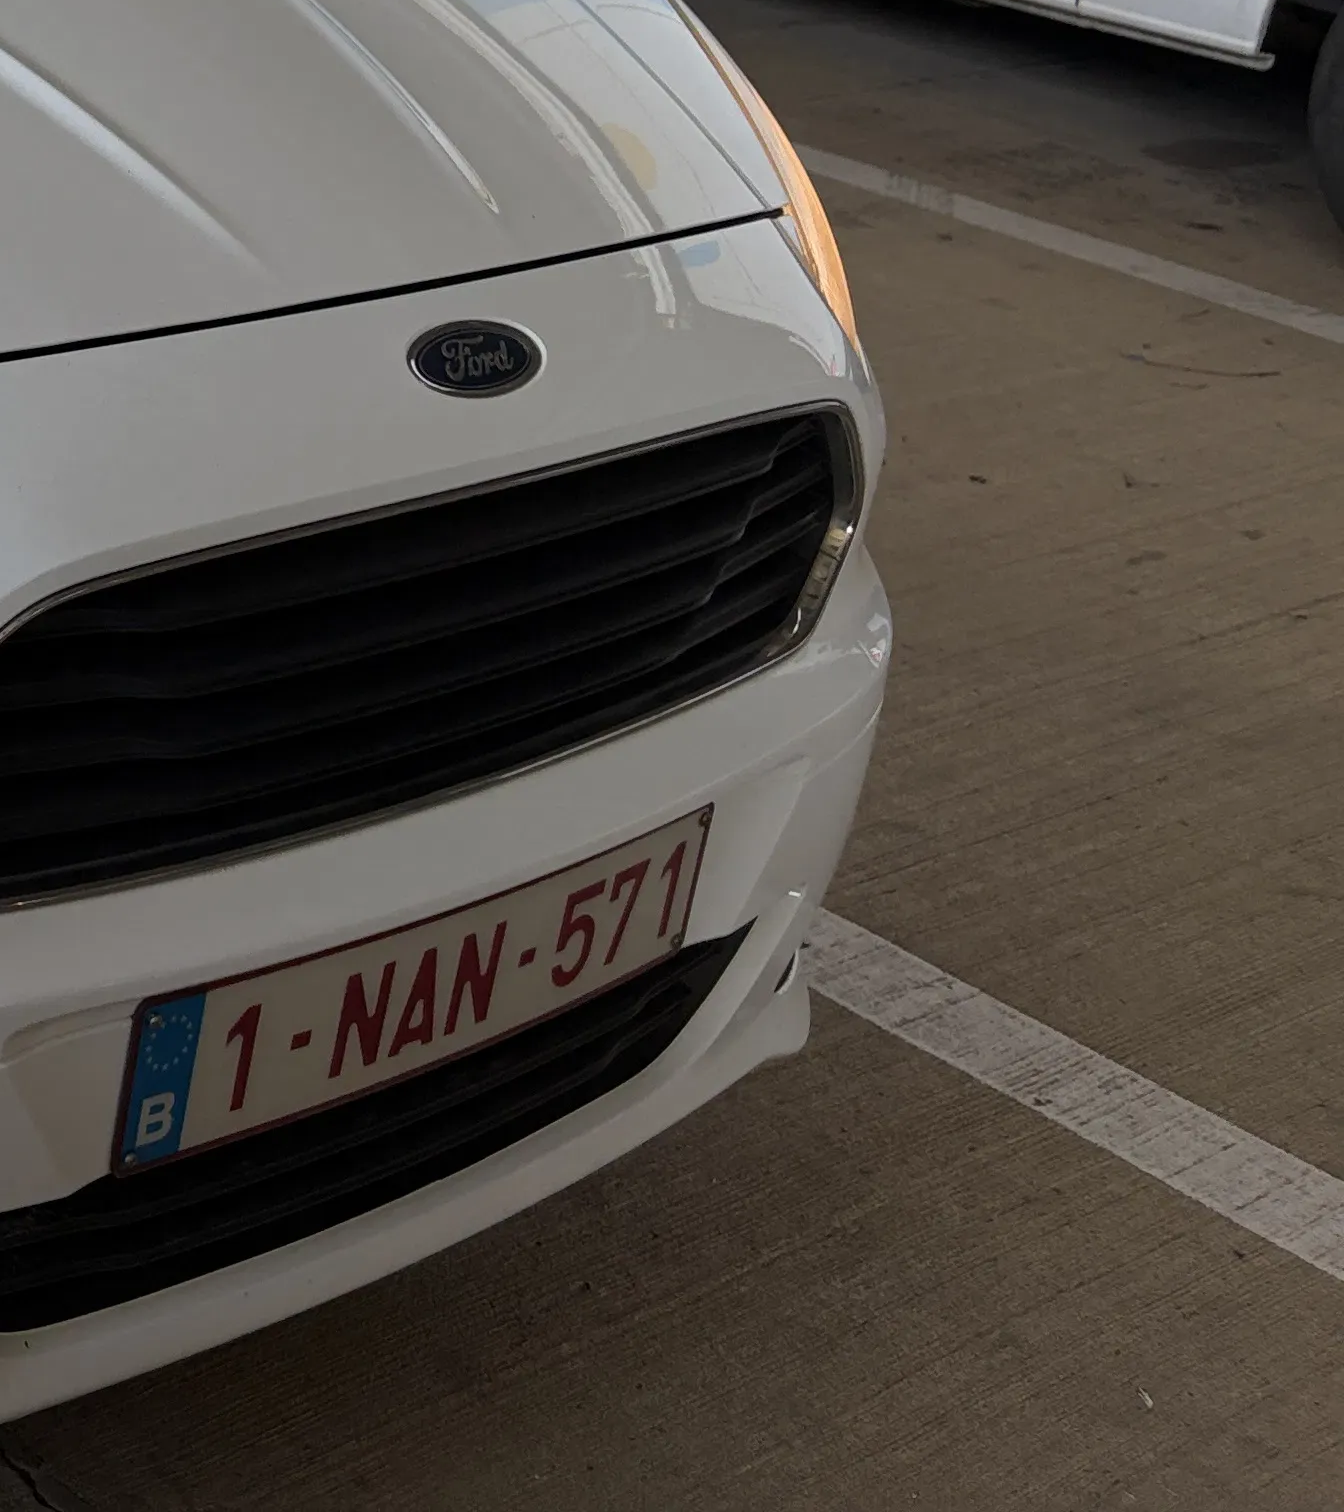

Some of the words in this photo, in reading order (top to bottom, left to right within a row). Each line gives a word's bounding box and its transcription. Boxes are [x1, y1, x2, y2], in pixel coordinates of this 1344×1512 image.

[441, 335, 513, 381] Ford
[224, 840, 686, 1112] 1-NAN-571
[135, 1092, 176, 1147] B
